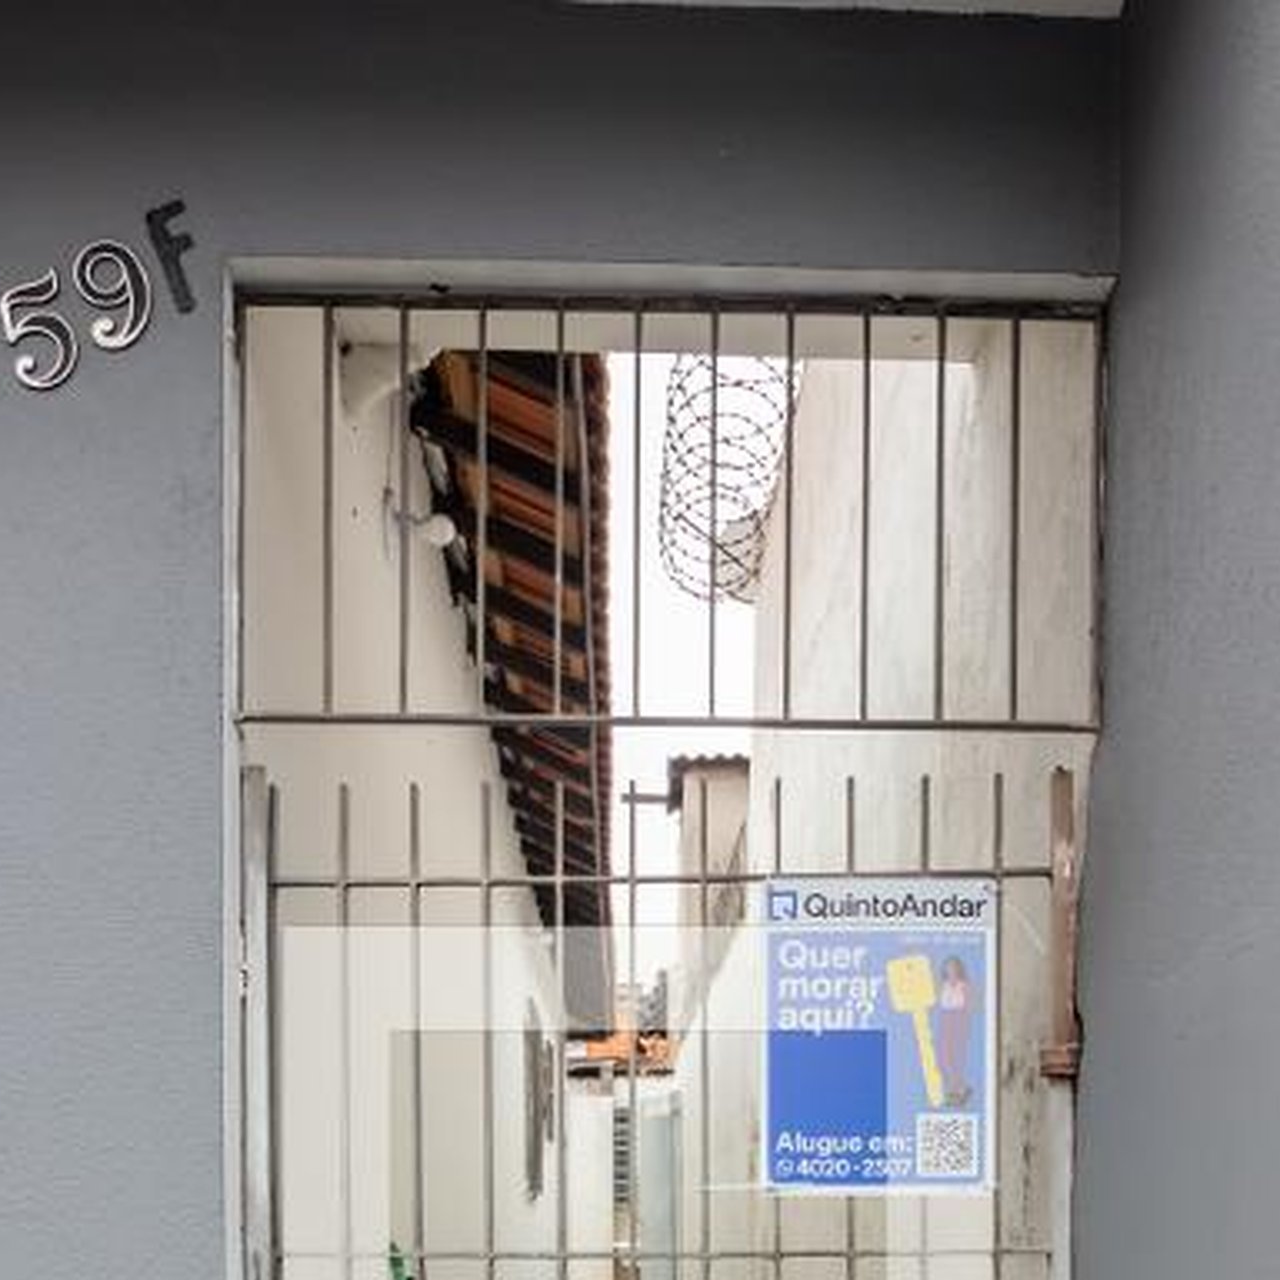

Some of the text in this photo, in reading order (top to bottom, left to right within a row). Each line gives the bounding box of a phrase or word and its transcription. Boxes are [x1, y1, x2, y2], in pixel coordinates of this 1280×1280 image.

[803, 893, 987, 919] QuintoAndar
[779, 939, 865, 970] Quer
[779, 975, 883, 999] morar
[778, 1001, 874, 1036] aqui?
[776, 1132, 862, 1157] Alugue
